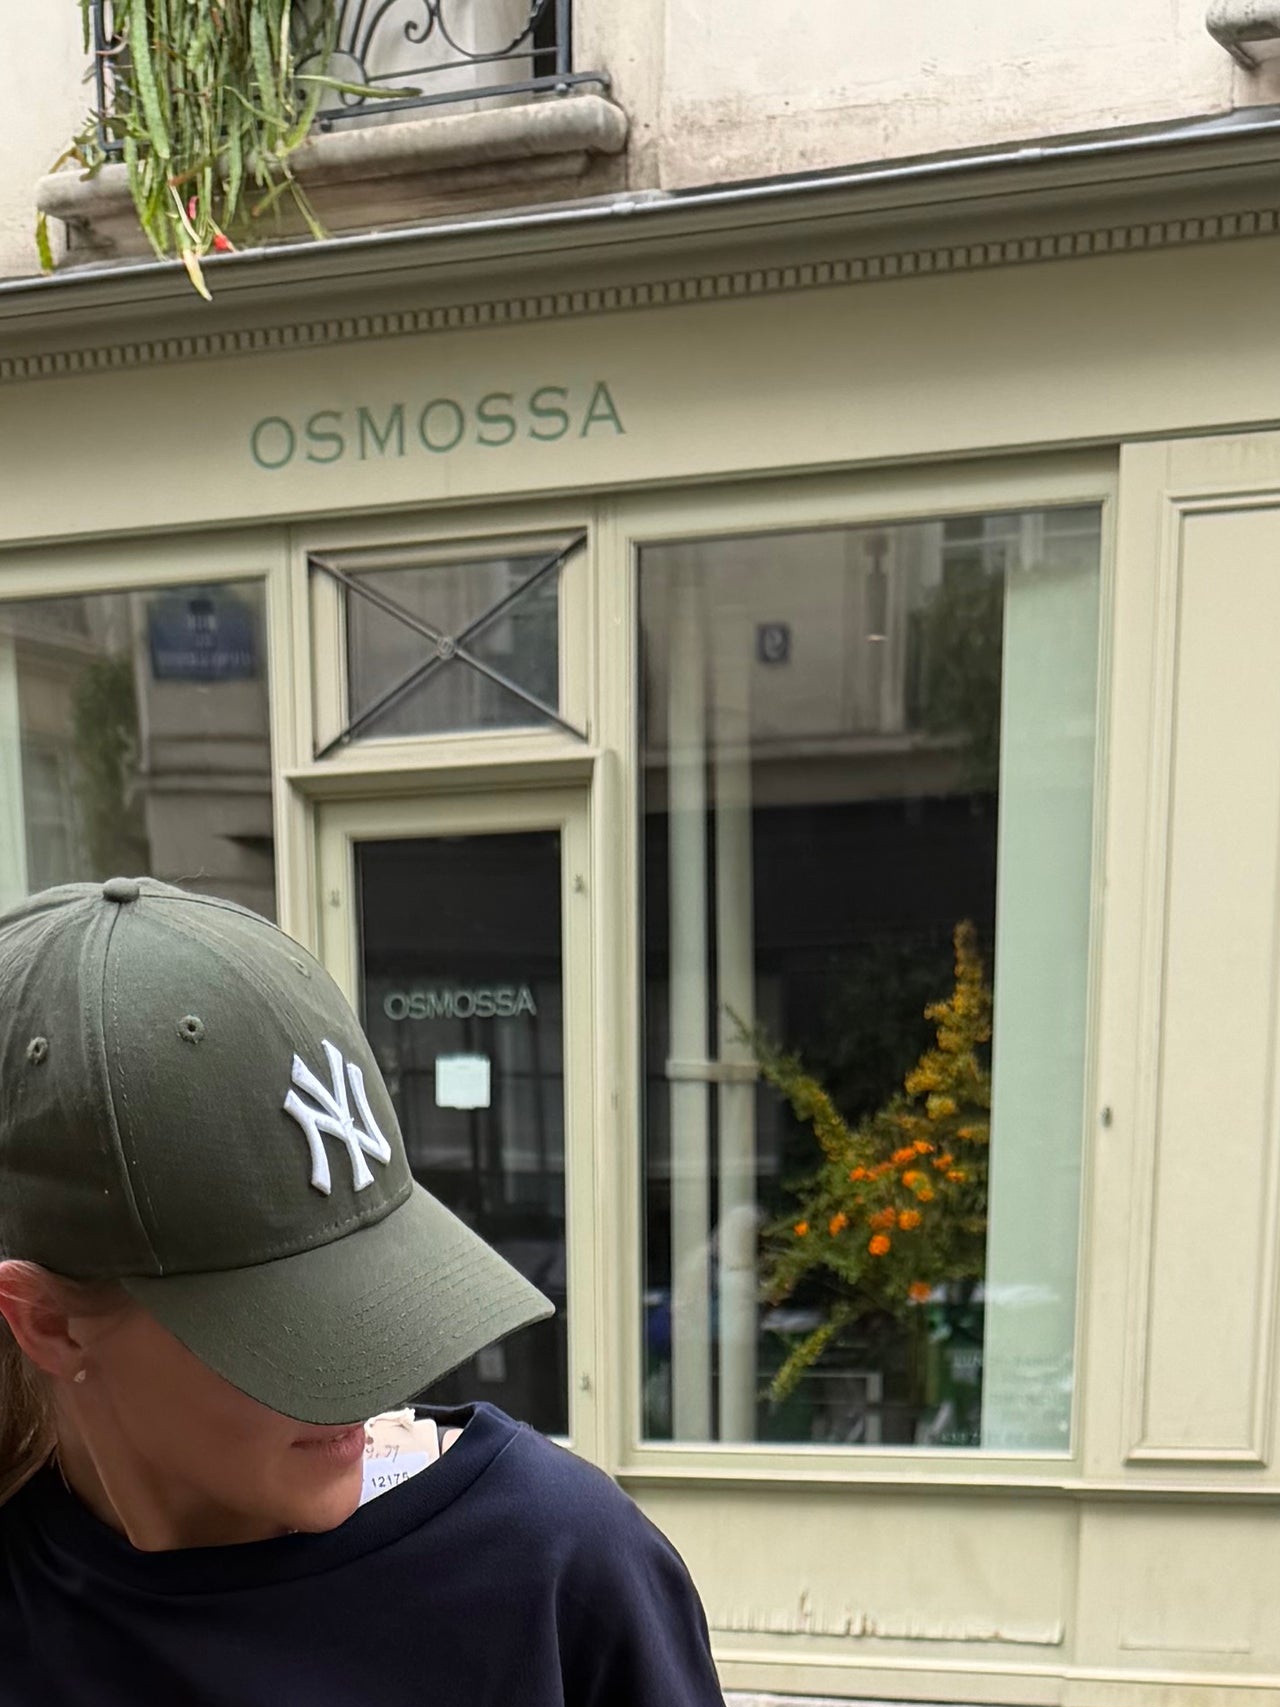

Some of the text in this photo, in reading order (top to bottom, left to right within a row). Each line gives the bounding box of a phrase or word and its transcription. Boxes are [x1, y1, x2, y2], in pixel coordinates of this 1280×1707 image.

[250, 380, 626, 470] OSMOSSA
[384, 984, 536, 1020] OSMOSSA
[283, 1039, 391, 1196] NY
